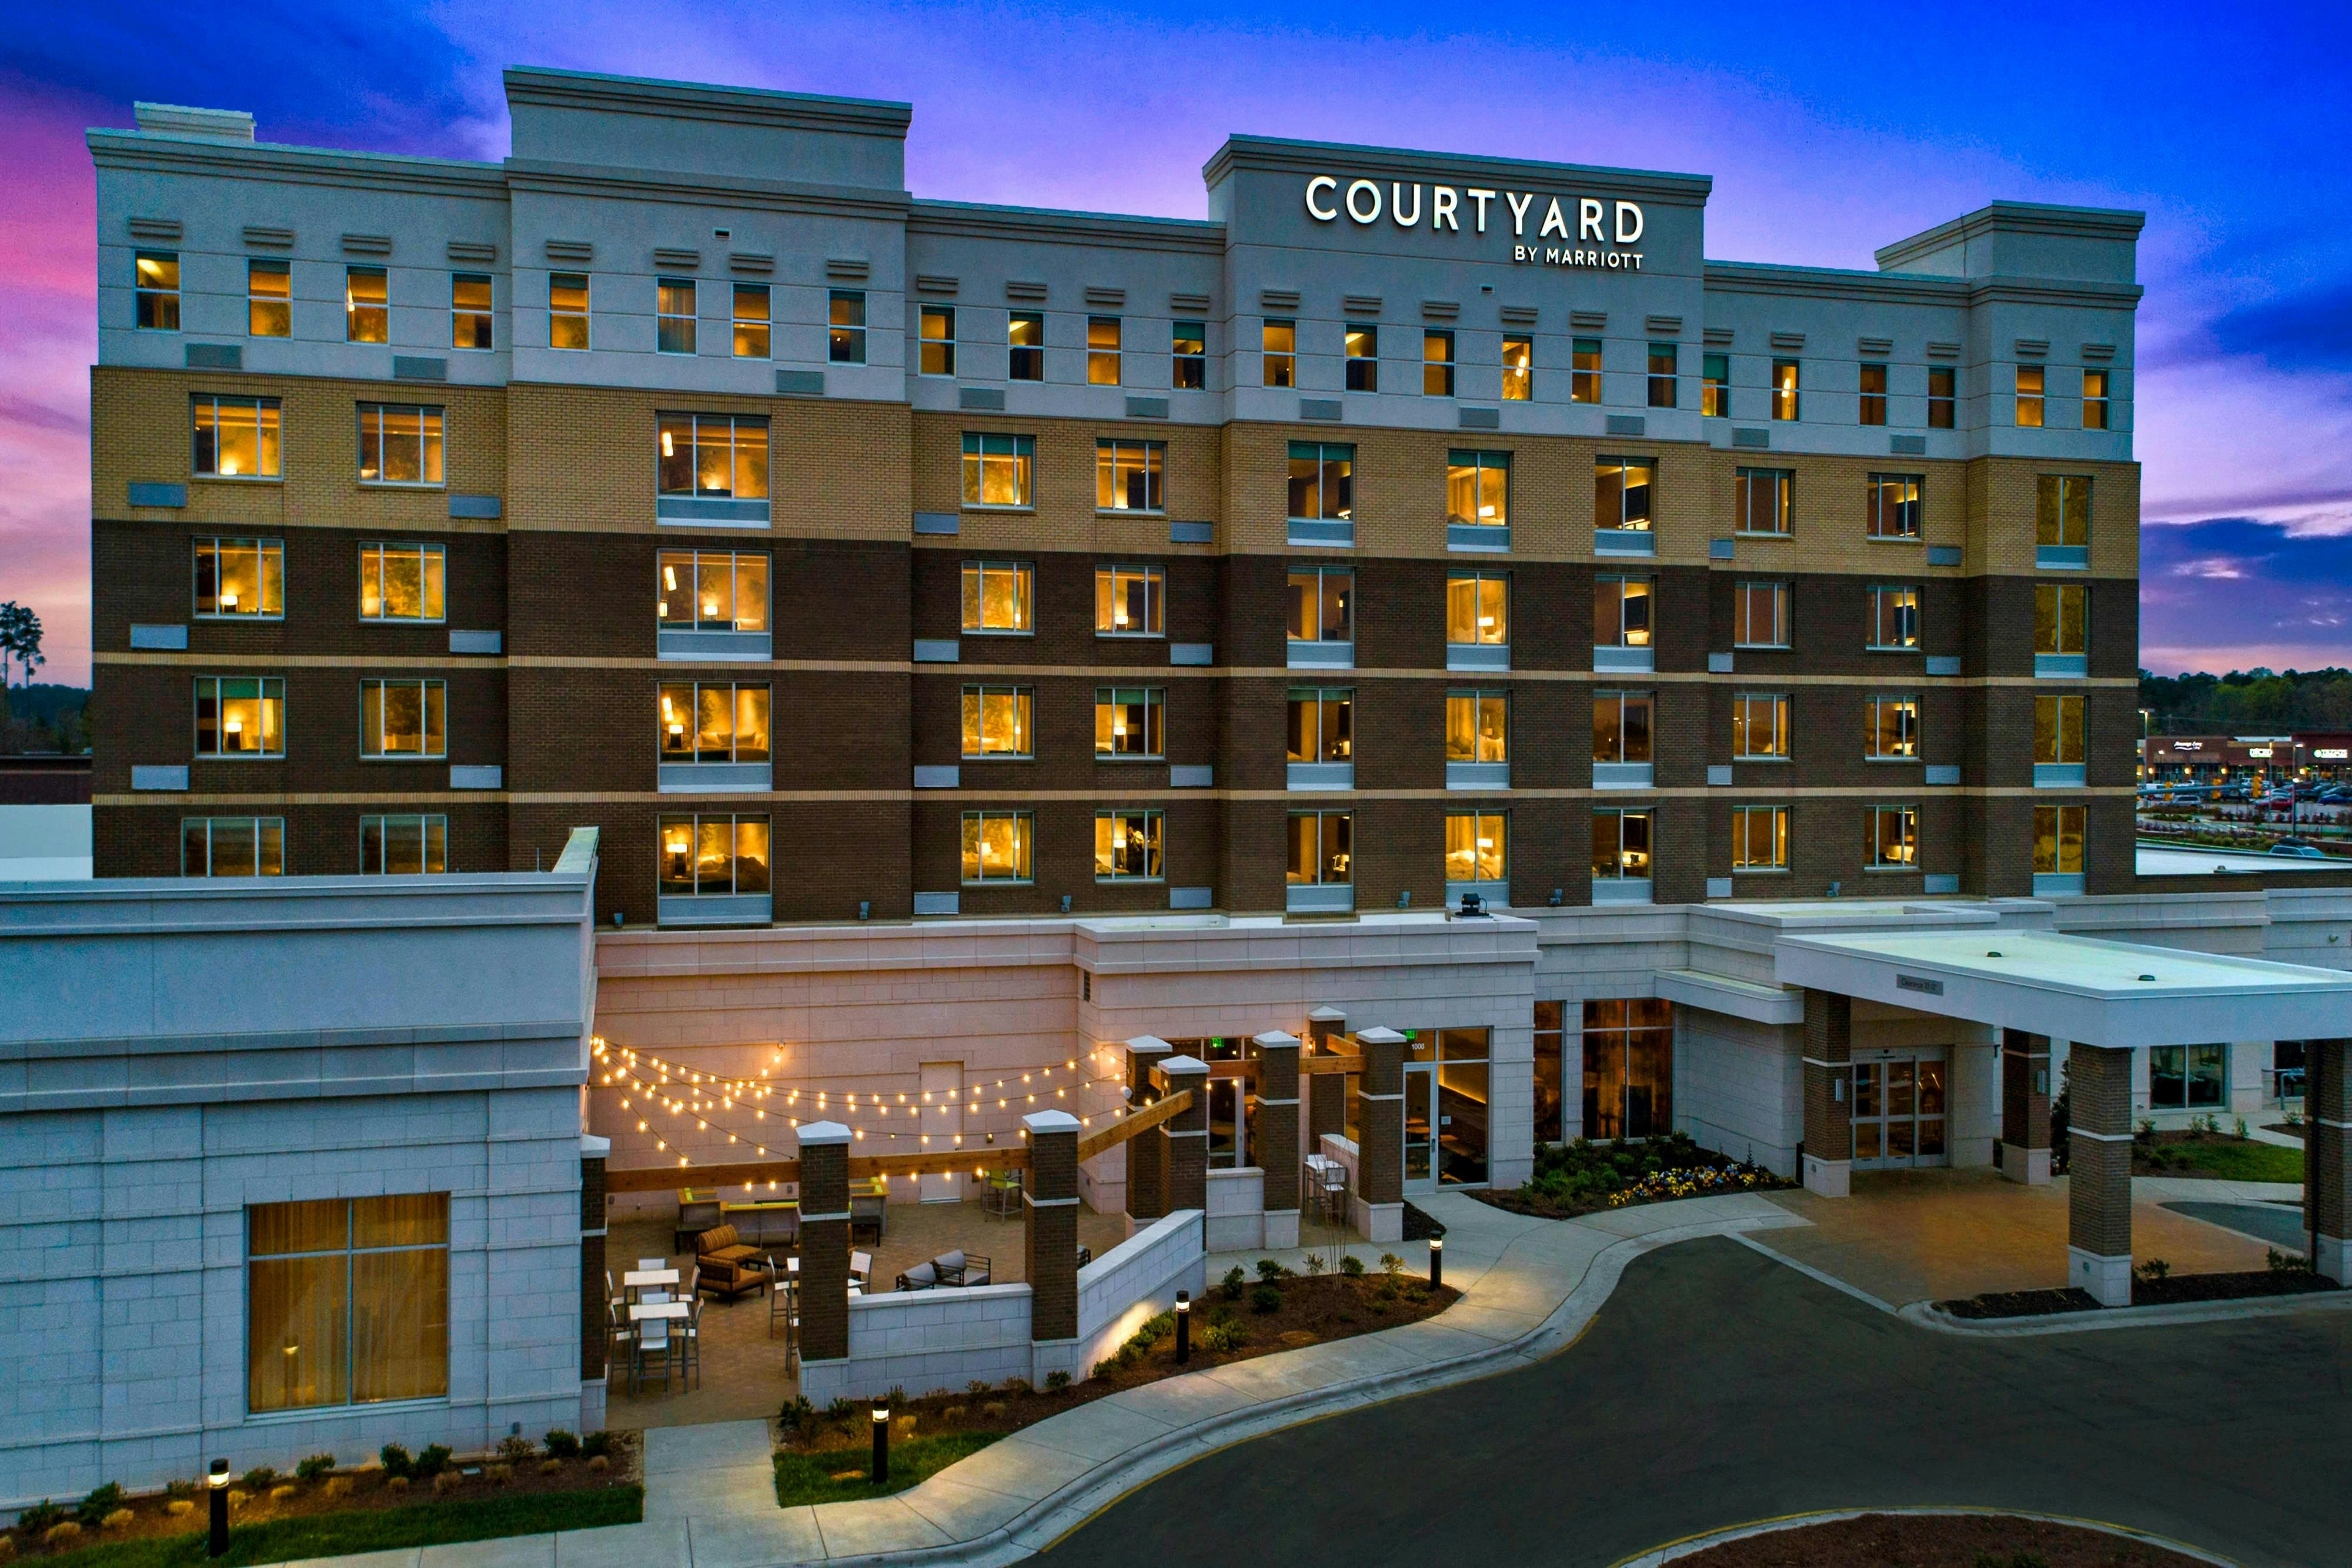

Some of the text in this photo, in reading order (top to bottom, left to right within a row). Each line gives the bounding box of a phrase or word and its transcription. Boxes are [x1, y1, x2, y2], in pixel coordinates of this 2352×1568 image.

[1305, 176, 1643, 243] COURTYARD
[1515, 245, 1643, 269] BY MARRIOTT
